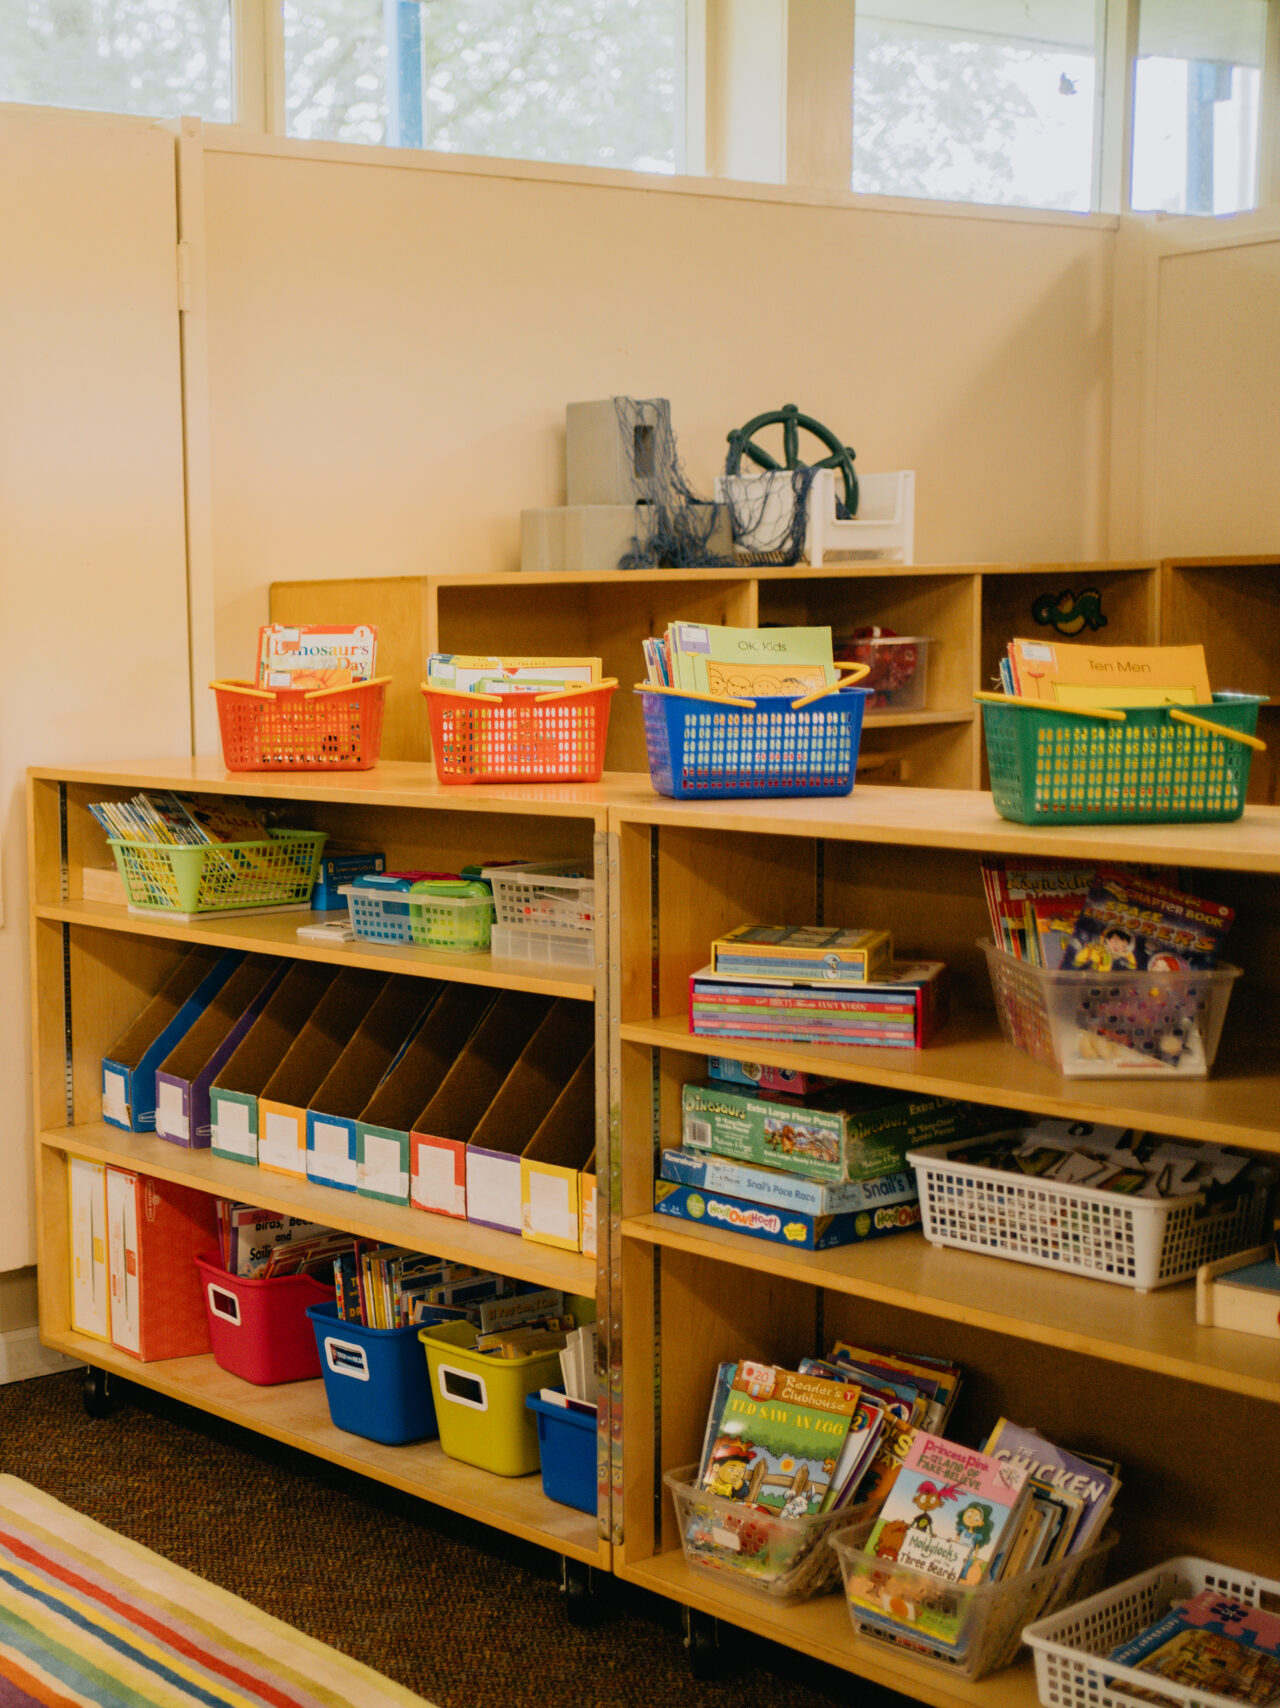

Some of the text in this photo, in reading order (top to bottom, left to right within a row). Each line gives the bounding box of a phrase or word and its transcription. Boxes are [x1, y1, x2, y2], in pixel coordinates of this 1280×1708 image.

[737, 640, 787, 652] OK Kids
[336, 656, 368, 674] Day
[1088, 660, 1152, 673] Ten Men
[1104, 901, 1164, 924] SPACE
[1185, 908, 1226, 929] BOOK
[1084, 907, 1217, 953] EXPLORERS
[746, 1103, 840, 1129] Extra Large Floor Puzzle
[909, 1101, 936, 1116] Extra
[746, 1178, 816, 1203] Snail's Pace Race
[863, 1174, 905, 1200] Snail's
[275, 1230, 292, 1242] and
[250, 1245, 274, 1261] Saili
[753, 1369, 769, 1383] 20
[784, 1374, 842, 1399] Reader's
[781, 1388, 847, 1412] Clubhouse
[731, 1399, 844, 1436] TED SAW AN EGG
[851, 1416, 863, 1431] 2
[922, 1439, 990, 1472] Princess Pink
[1017, 1445, 1038, 1457] THE
[916, 1453, 982, 1491] FAKE-BELIEVE
[938, 1456, 981, 1478] LAND OF
[908, 1535, 959, 1562] Moldylocks
[900, 1551, 957, 1581] Three Beards
